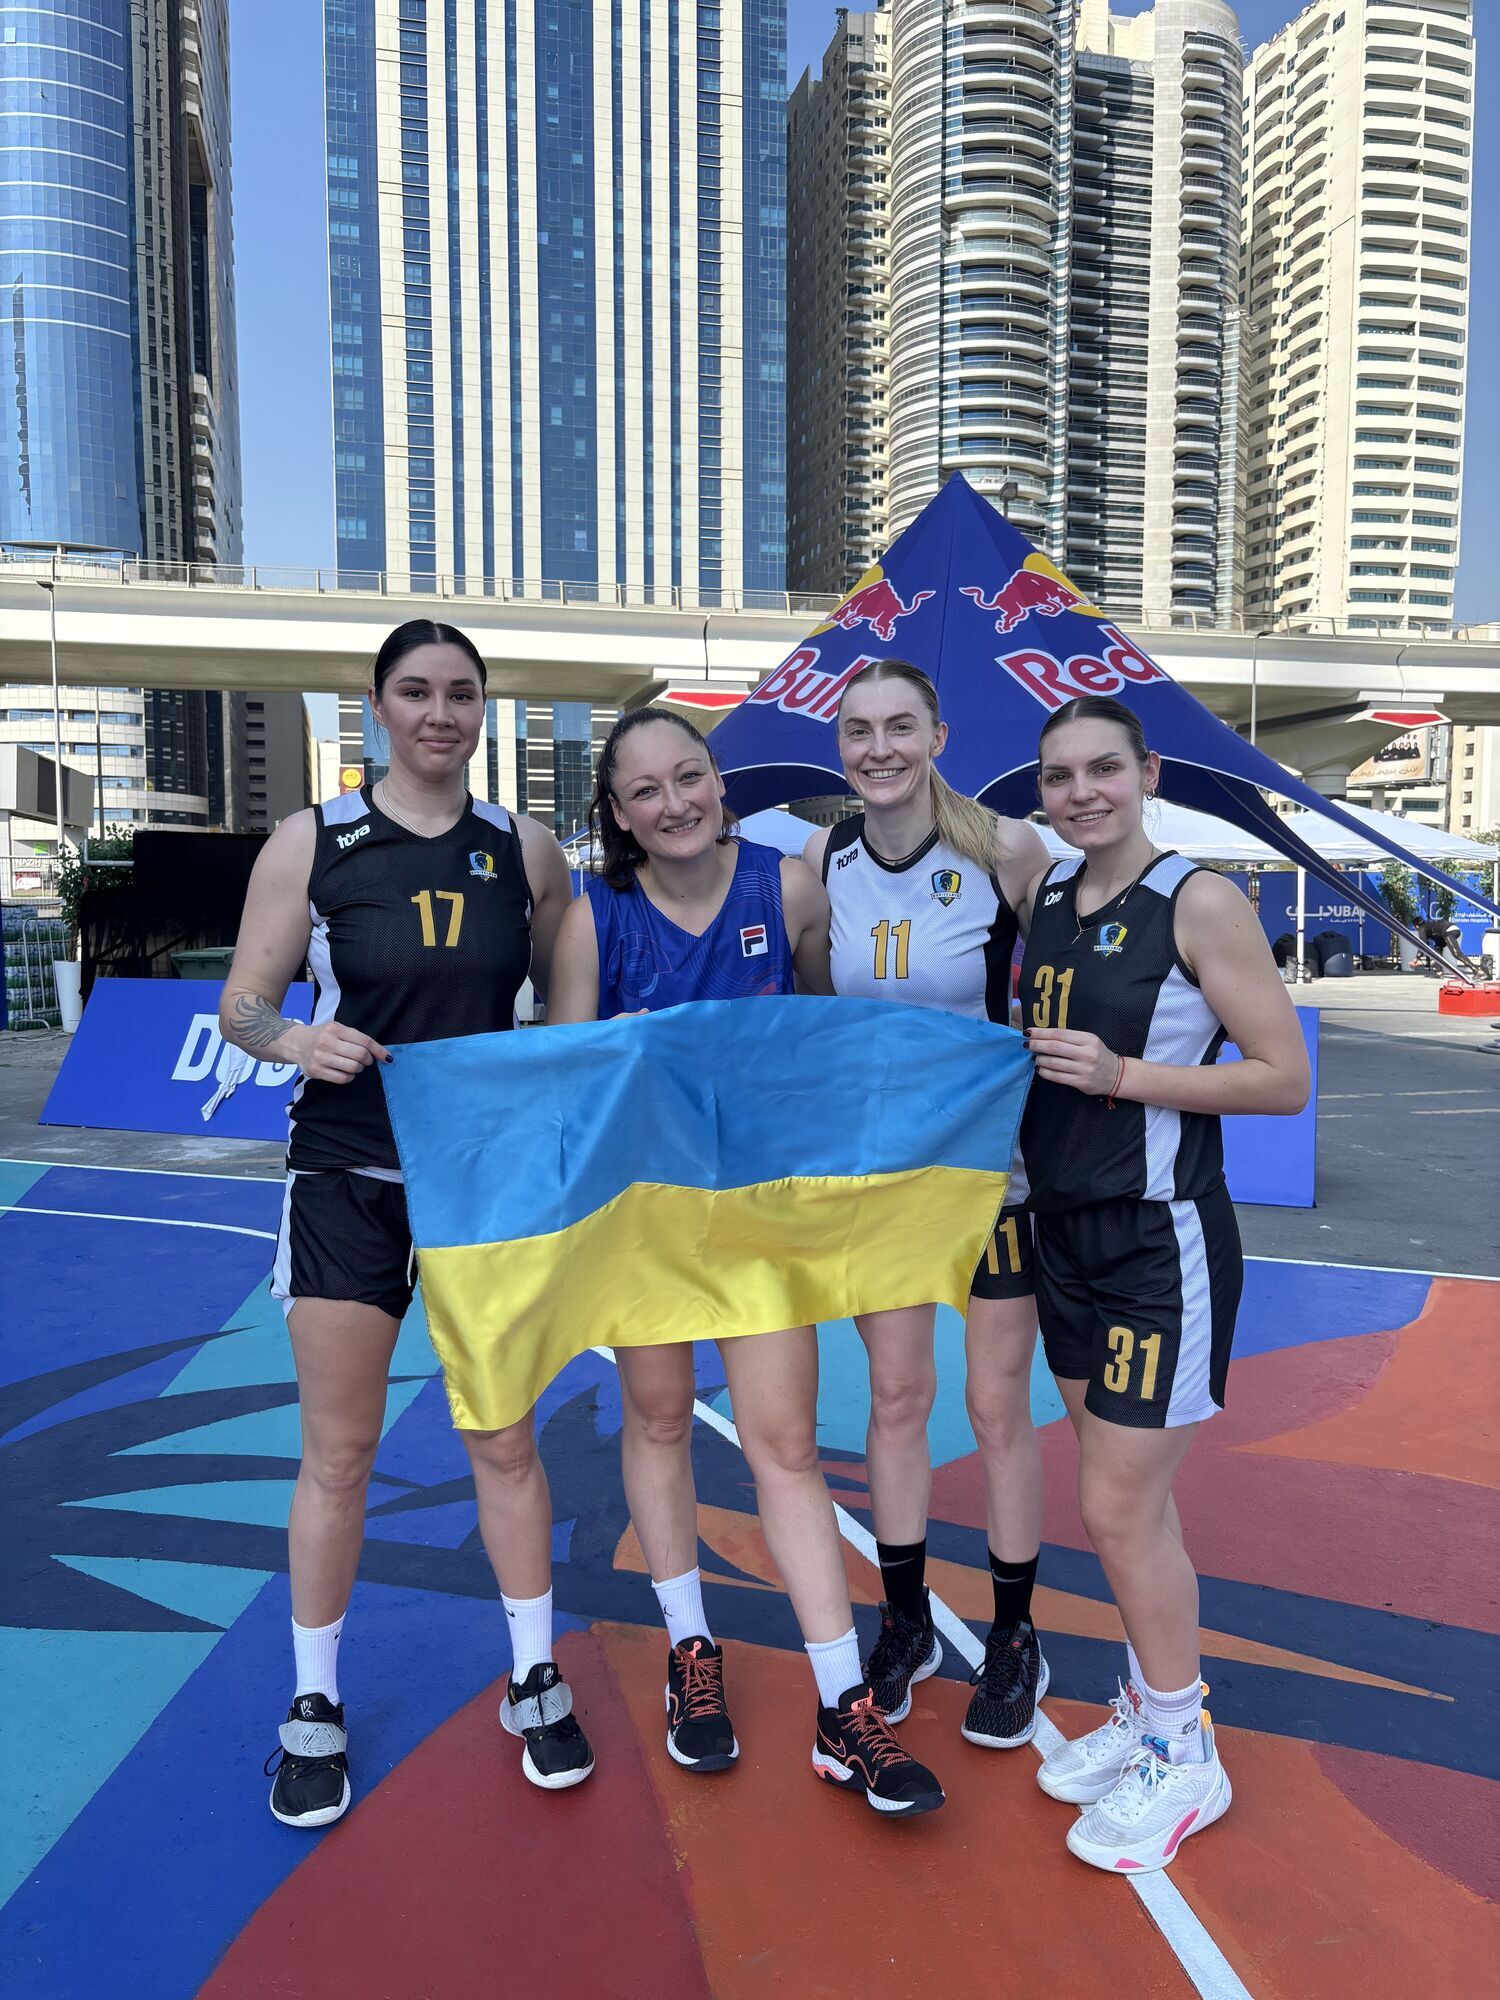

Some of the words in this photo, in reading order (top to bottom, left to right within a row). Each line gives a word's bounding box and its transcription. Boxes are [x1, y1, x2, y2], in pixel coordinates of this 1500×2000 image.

[994, 624, 1171, 713] Red
[410, 890, 465, 947] 17
[871, 920, 912, 979] 11
[1033, 965, 1075, 1029] 31
[986, 1216, 1022, 1275] 11
[1103, 1326, 1162, 1400] 31
